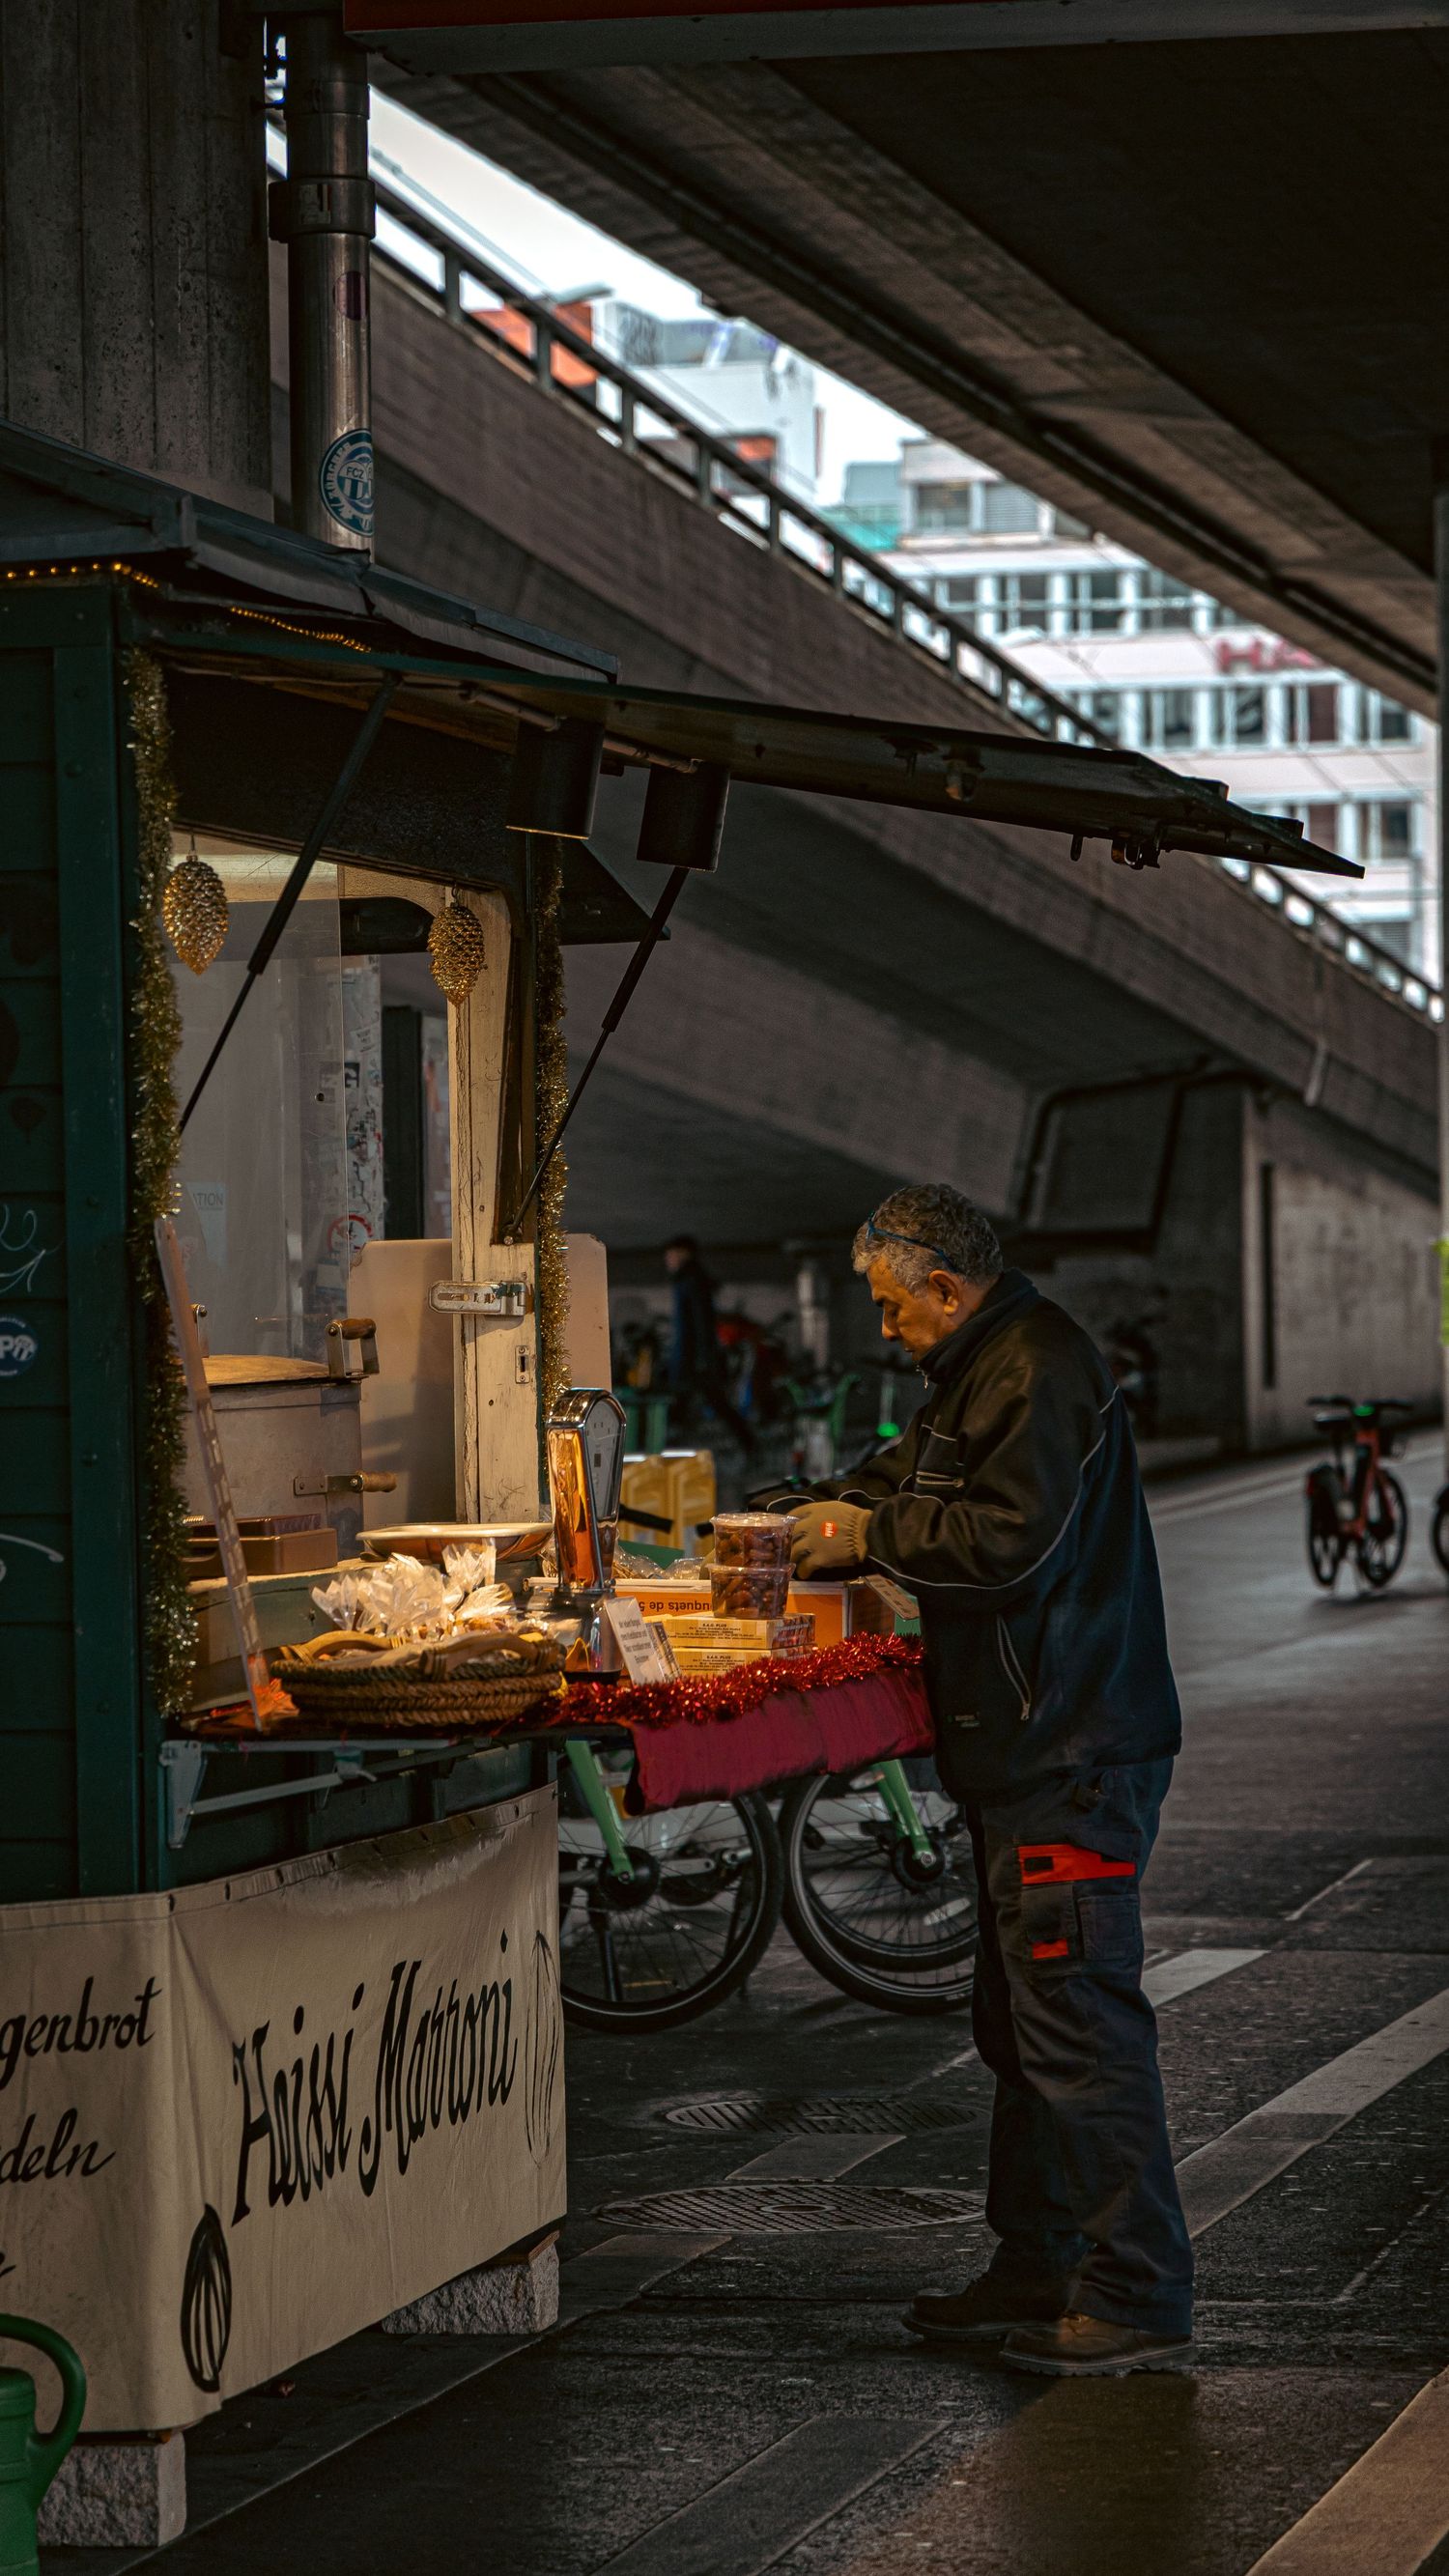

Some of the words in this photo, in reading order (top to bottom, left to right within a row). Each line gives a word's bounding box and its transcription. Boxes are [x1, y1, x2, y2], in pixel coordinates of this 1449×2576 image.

[346, 467, 365, 480] FCZ
[648, 1601, 664, 1612] de
[668, 1600, 712, 1612] uquets
[0, 1975, 162, 2089] genbrot
[232, 1983, 365, 2226] Heissi
[358, 1928, 518, 2197] Marroni
